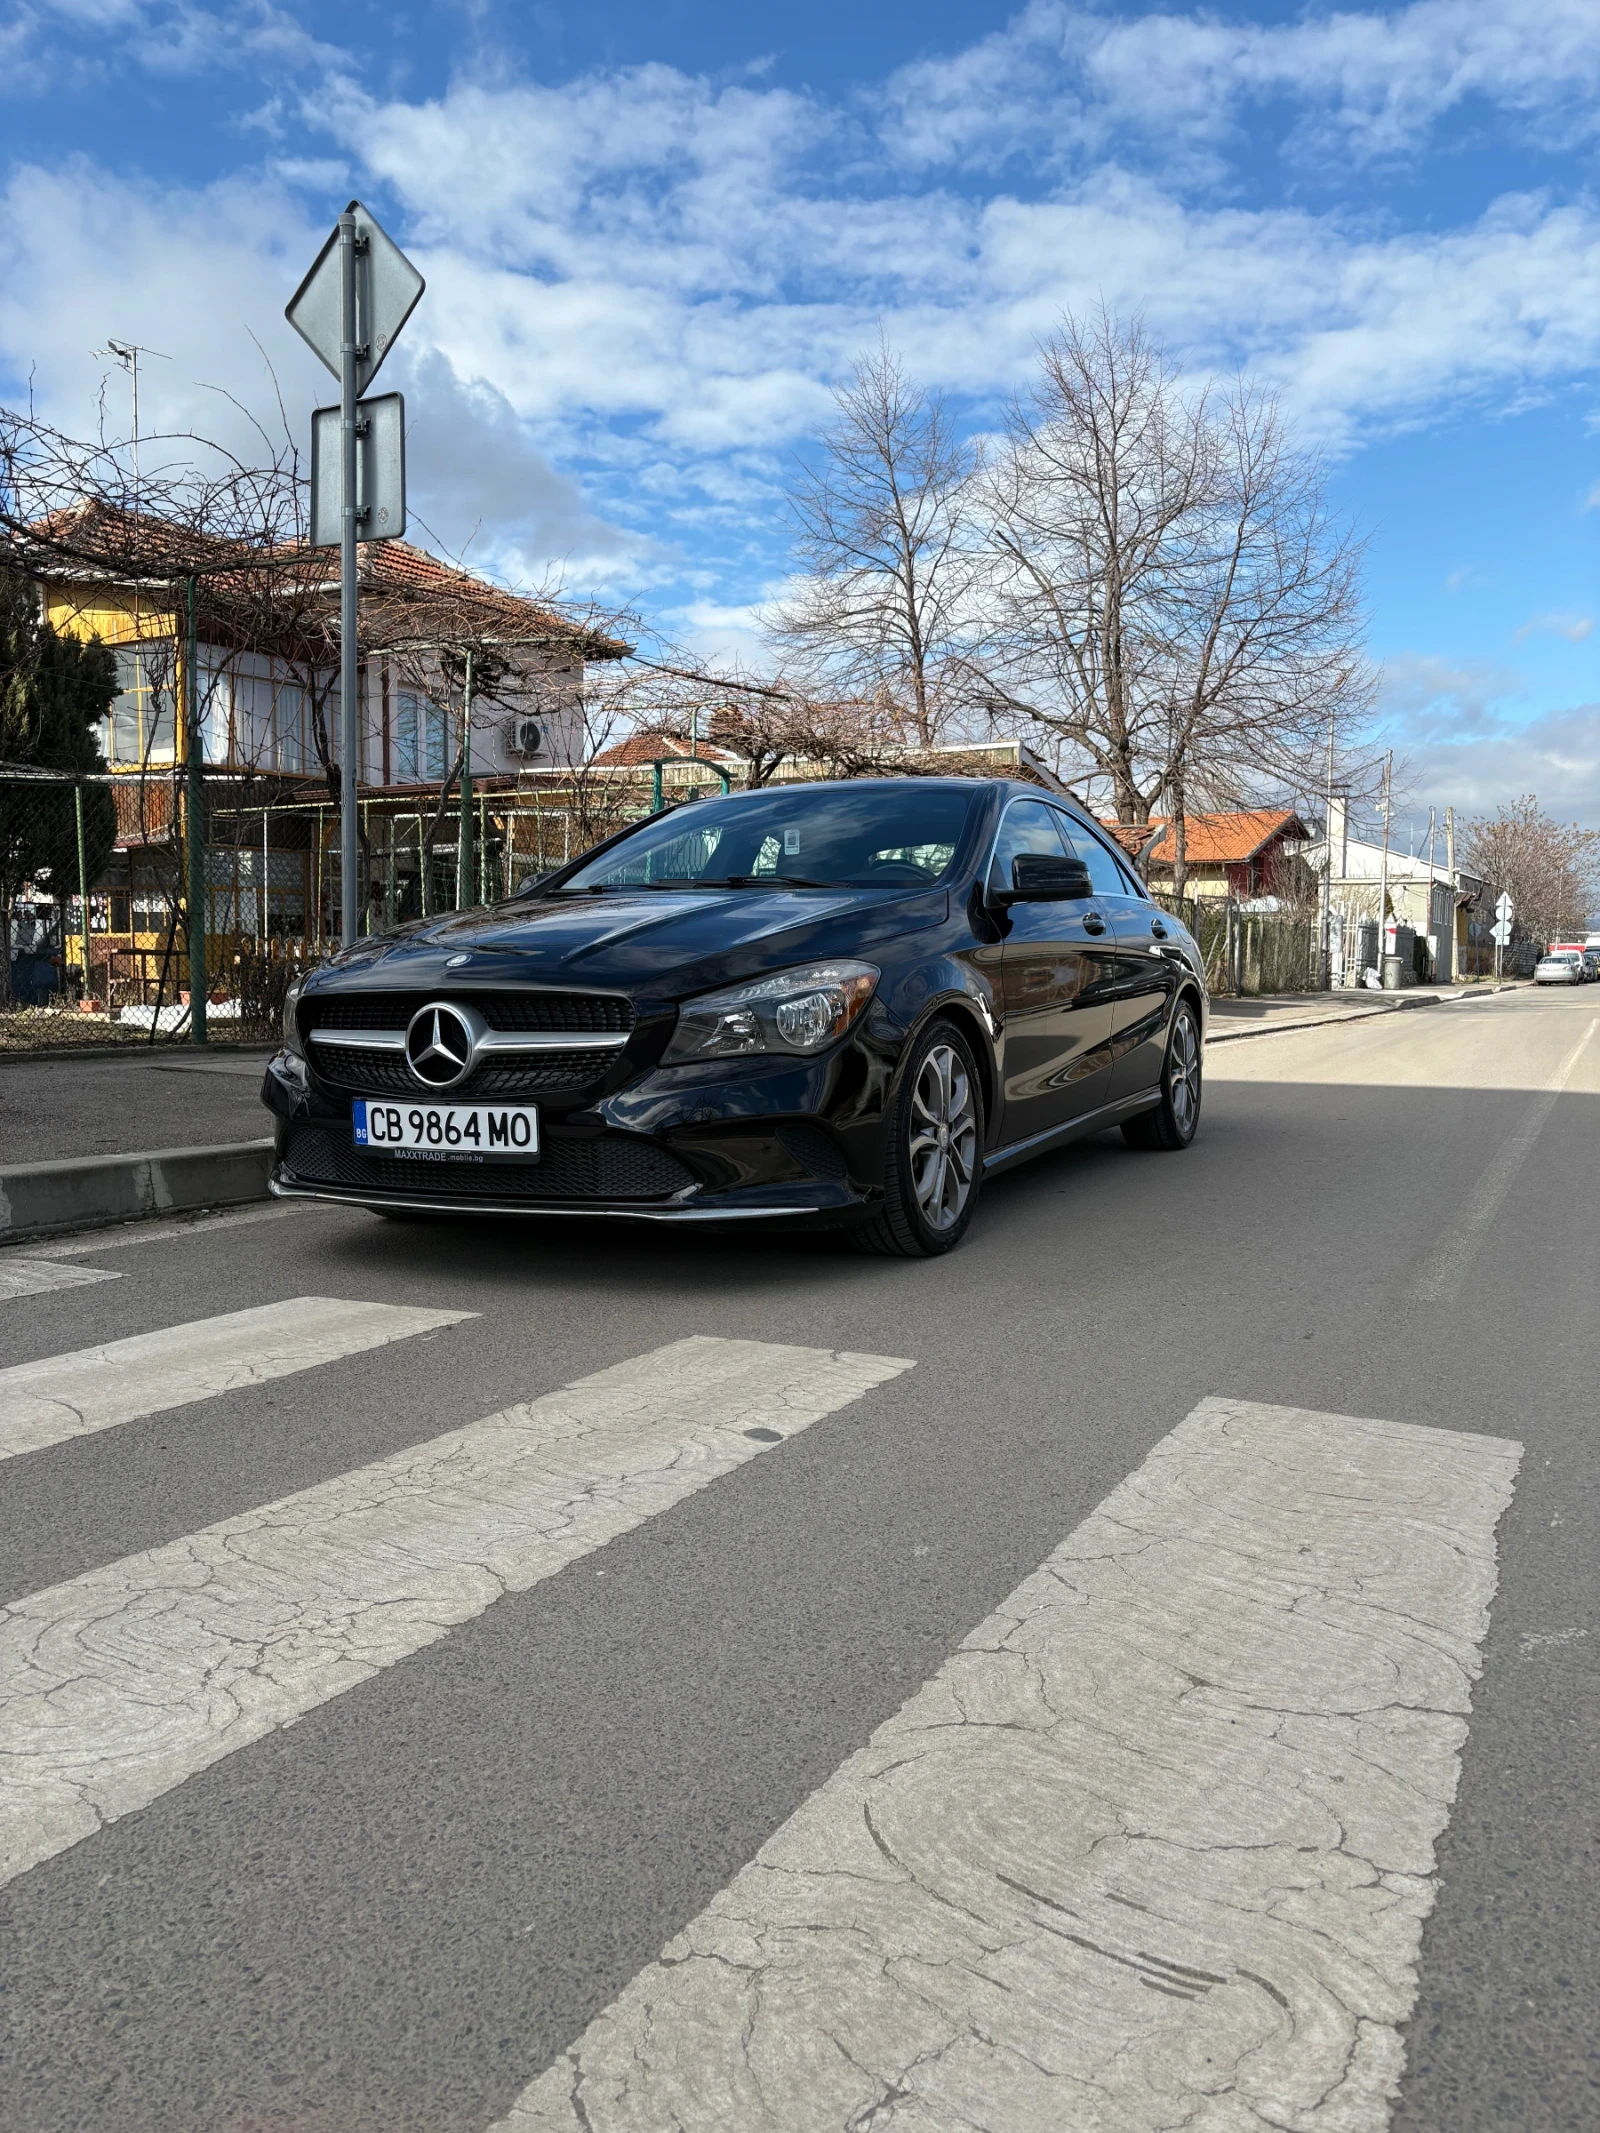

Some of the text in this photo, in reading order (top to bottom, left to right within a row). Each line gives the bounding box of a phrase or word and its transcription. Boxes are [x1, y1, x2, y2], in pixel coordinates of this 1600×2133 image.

[356, 1107, 531, 1147] BG CB 9864 MO
